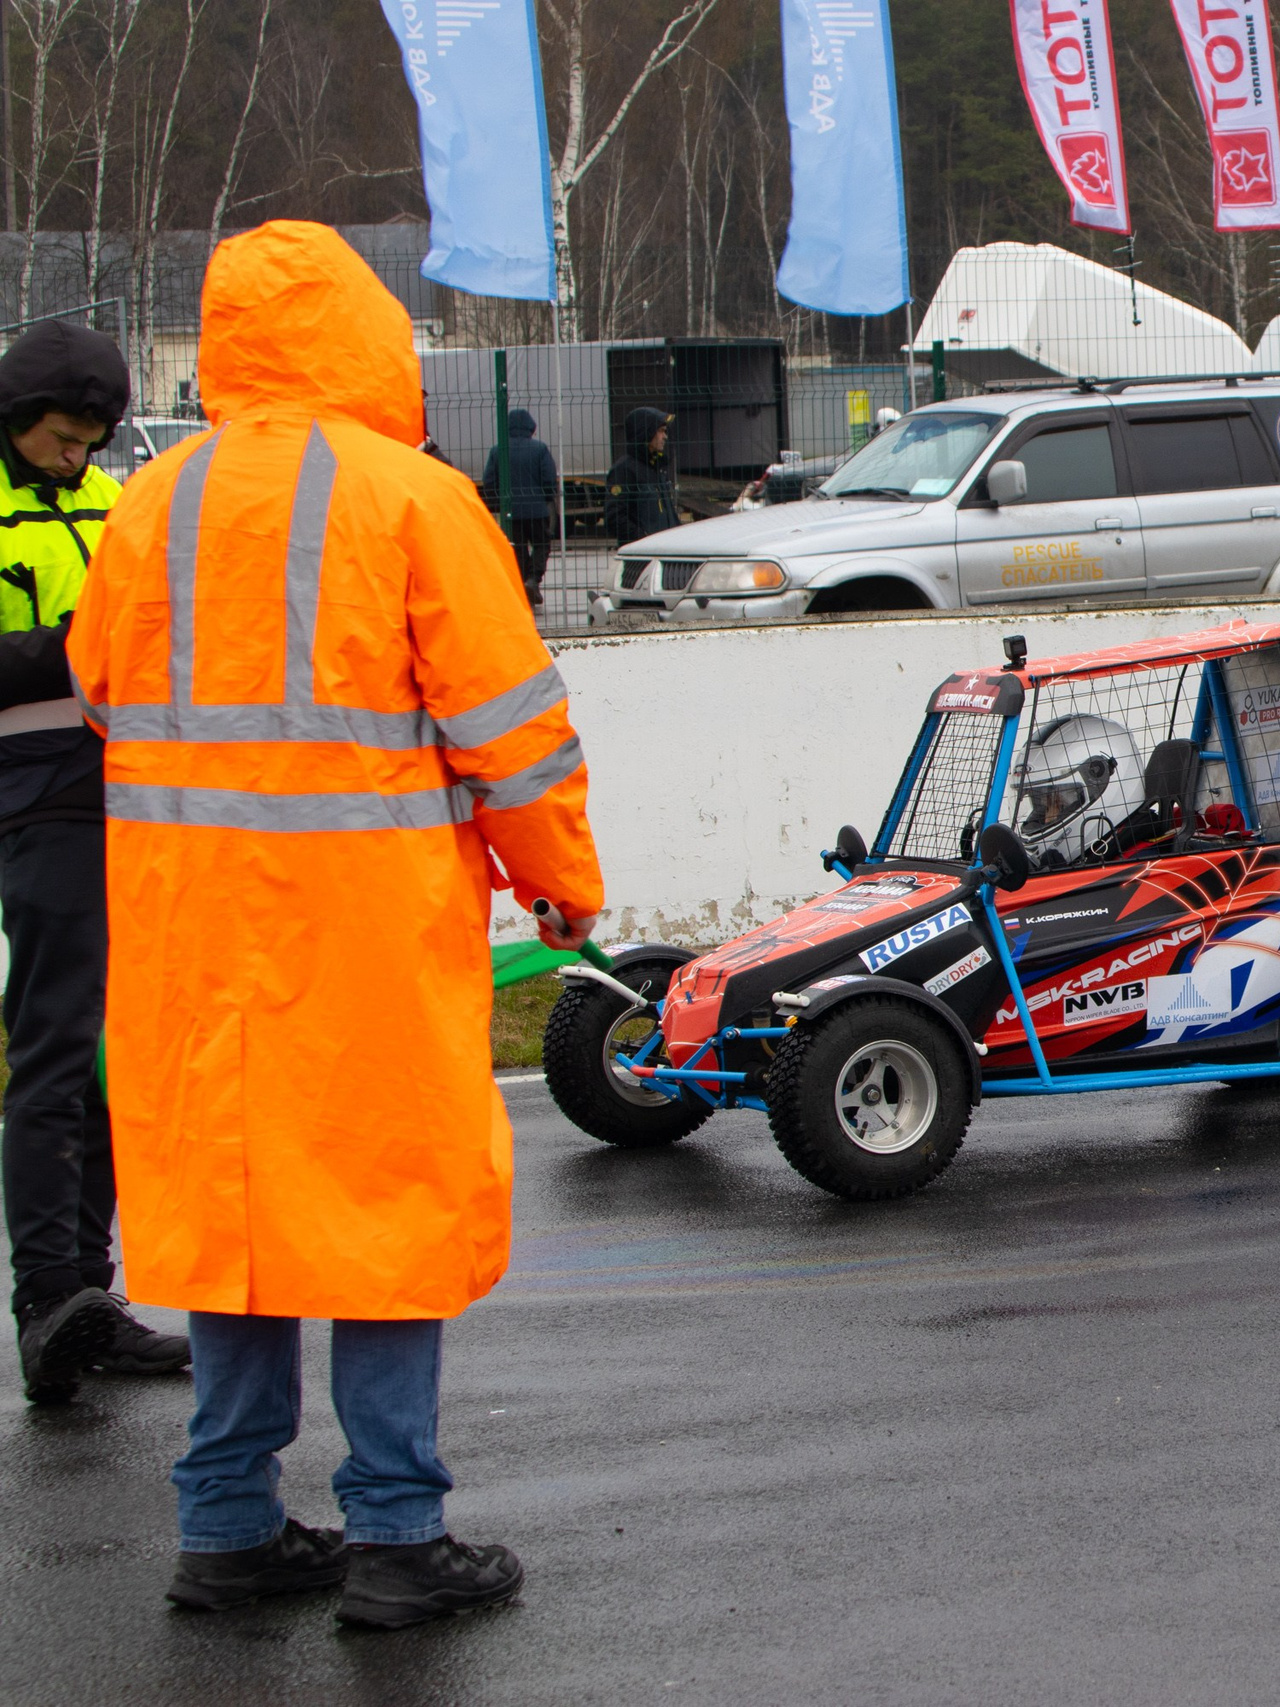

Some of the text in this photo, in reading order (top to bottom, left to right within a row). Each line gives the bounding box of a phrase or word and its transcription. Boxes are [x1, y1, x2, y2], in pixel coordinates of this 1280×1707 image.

[1041, 0, 1091, 126] ТОТ
[1201, 0, 1248, 123] ТОТ
[866, 905, 971, 971] RUSTA
[927, 959, 975, 995] DRYDRY
[1065, 981, 1145, 1015] NWB
[1065, 1014, 1086, 1024] NIPPON
[1086, 1011, 1102, 1020] WIPER
[1103, 1008, 1122, 1017] BLADE
[1150, 1011, 1230, 1026] АДВ Консалтинг
